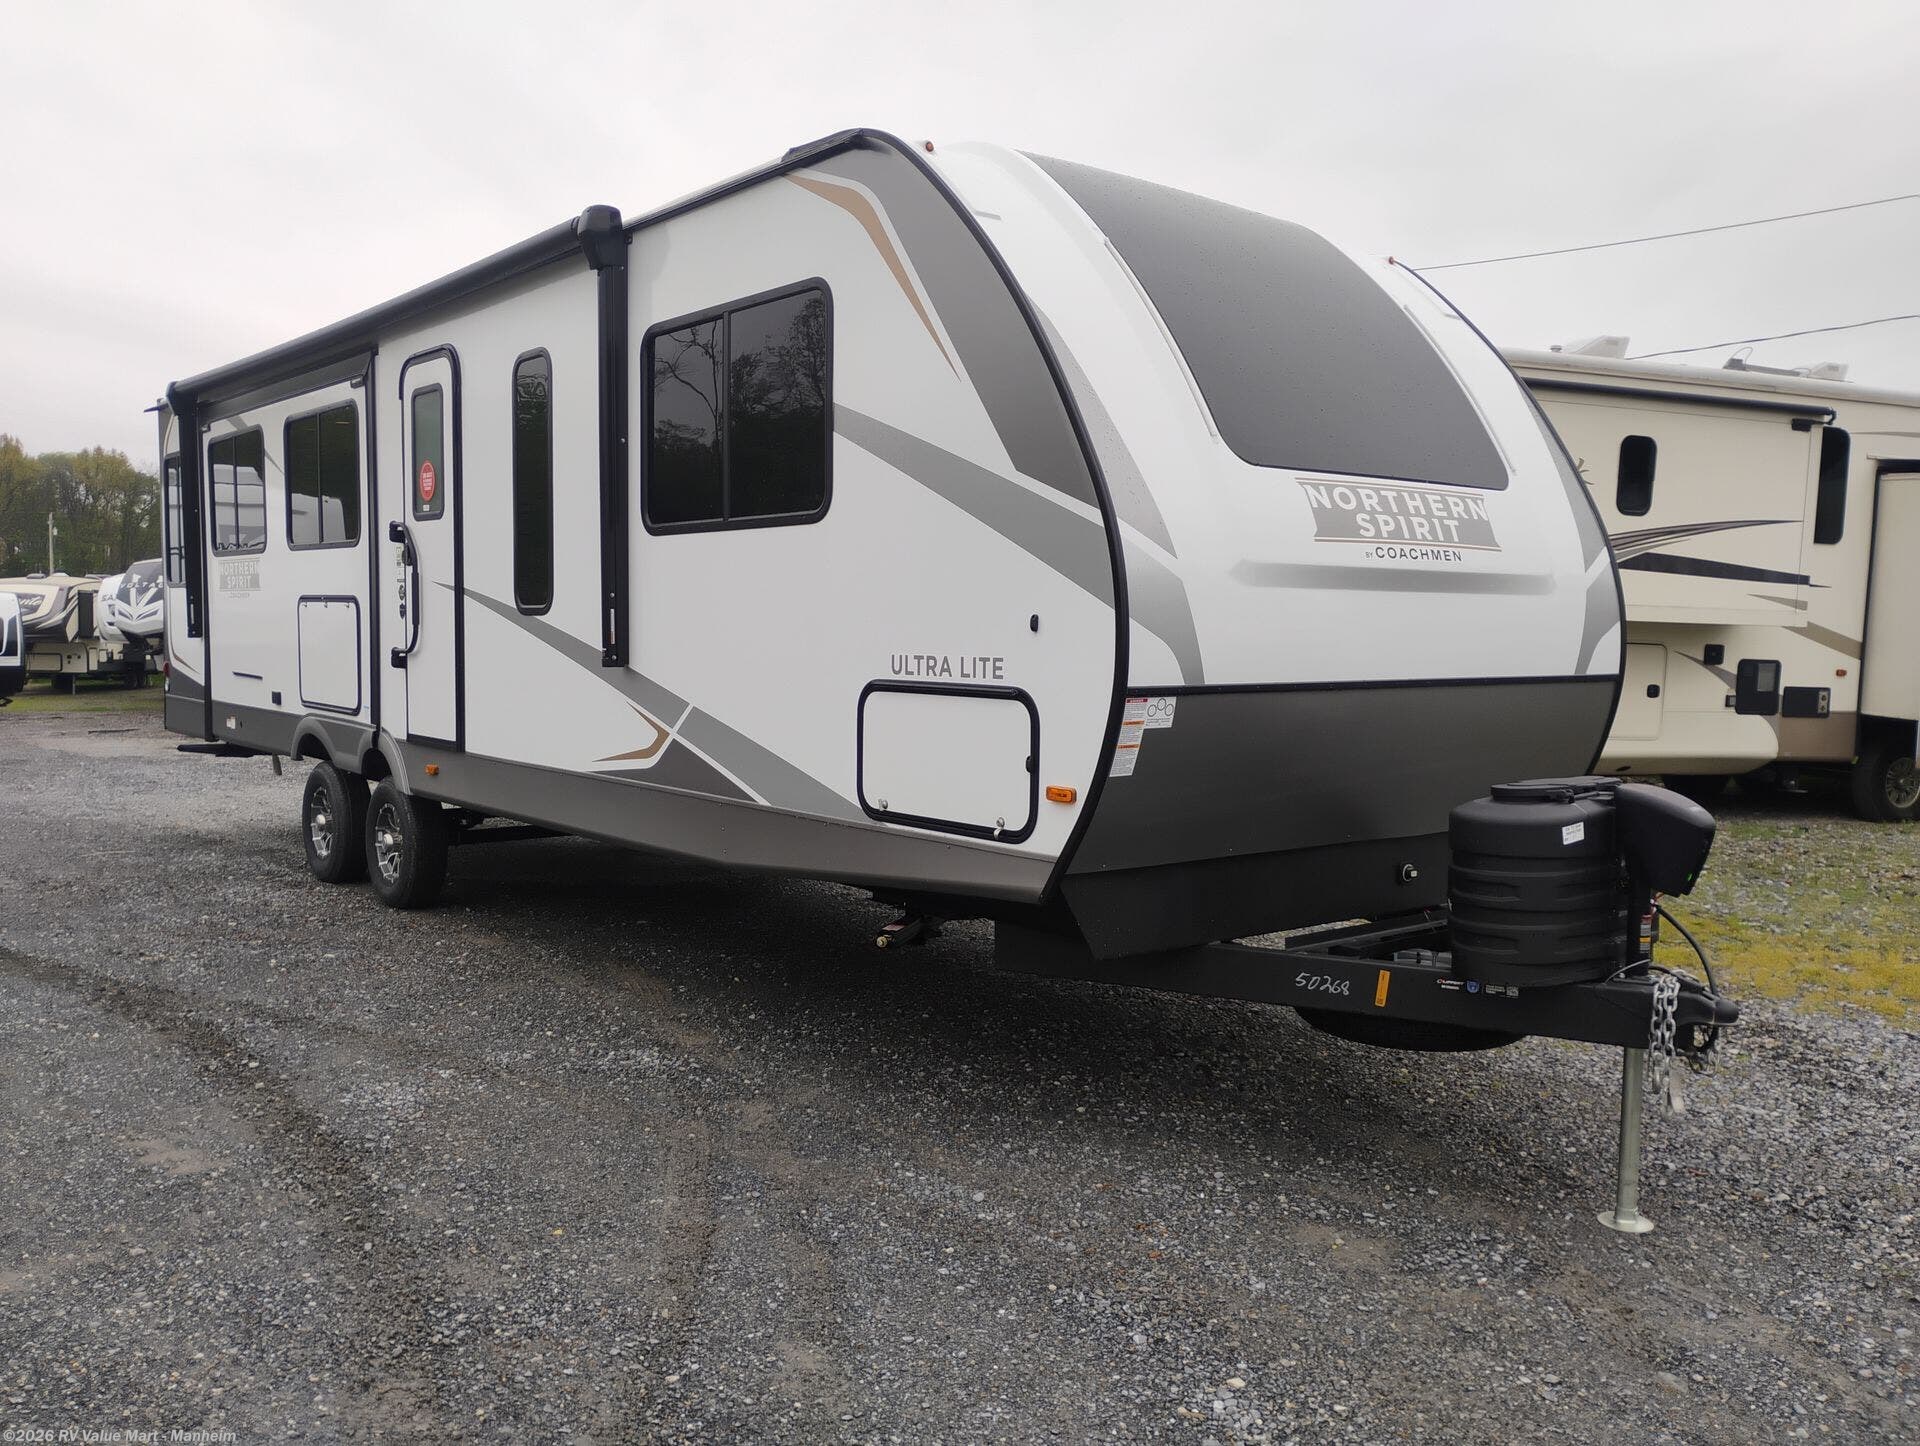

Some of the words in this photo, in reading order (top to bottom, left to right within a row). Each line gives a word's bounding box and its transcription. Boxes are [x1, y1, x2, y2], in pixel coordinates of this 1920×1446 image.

[1303, 484, 1488, 521] NORTHERN
[1356, 513, 1460, 542] SPIRIT
[1365, 551, 1374, 559] BY
[1375, 546, 1462, 562] COACHMEN
[891, 654, 953, 678] ULTRA
[960, 656, 1004, 680] LITE
[1295, 972, 1351, 996] 50268
